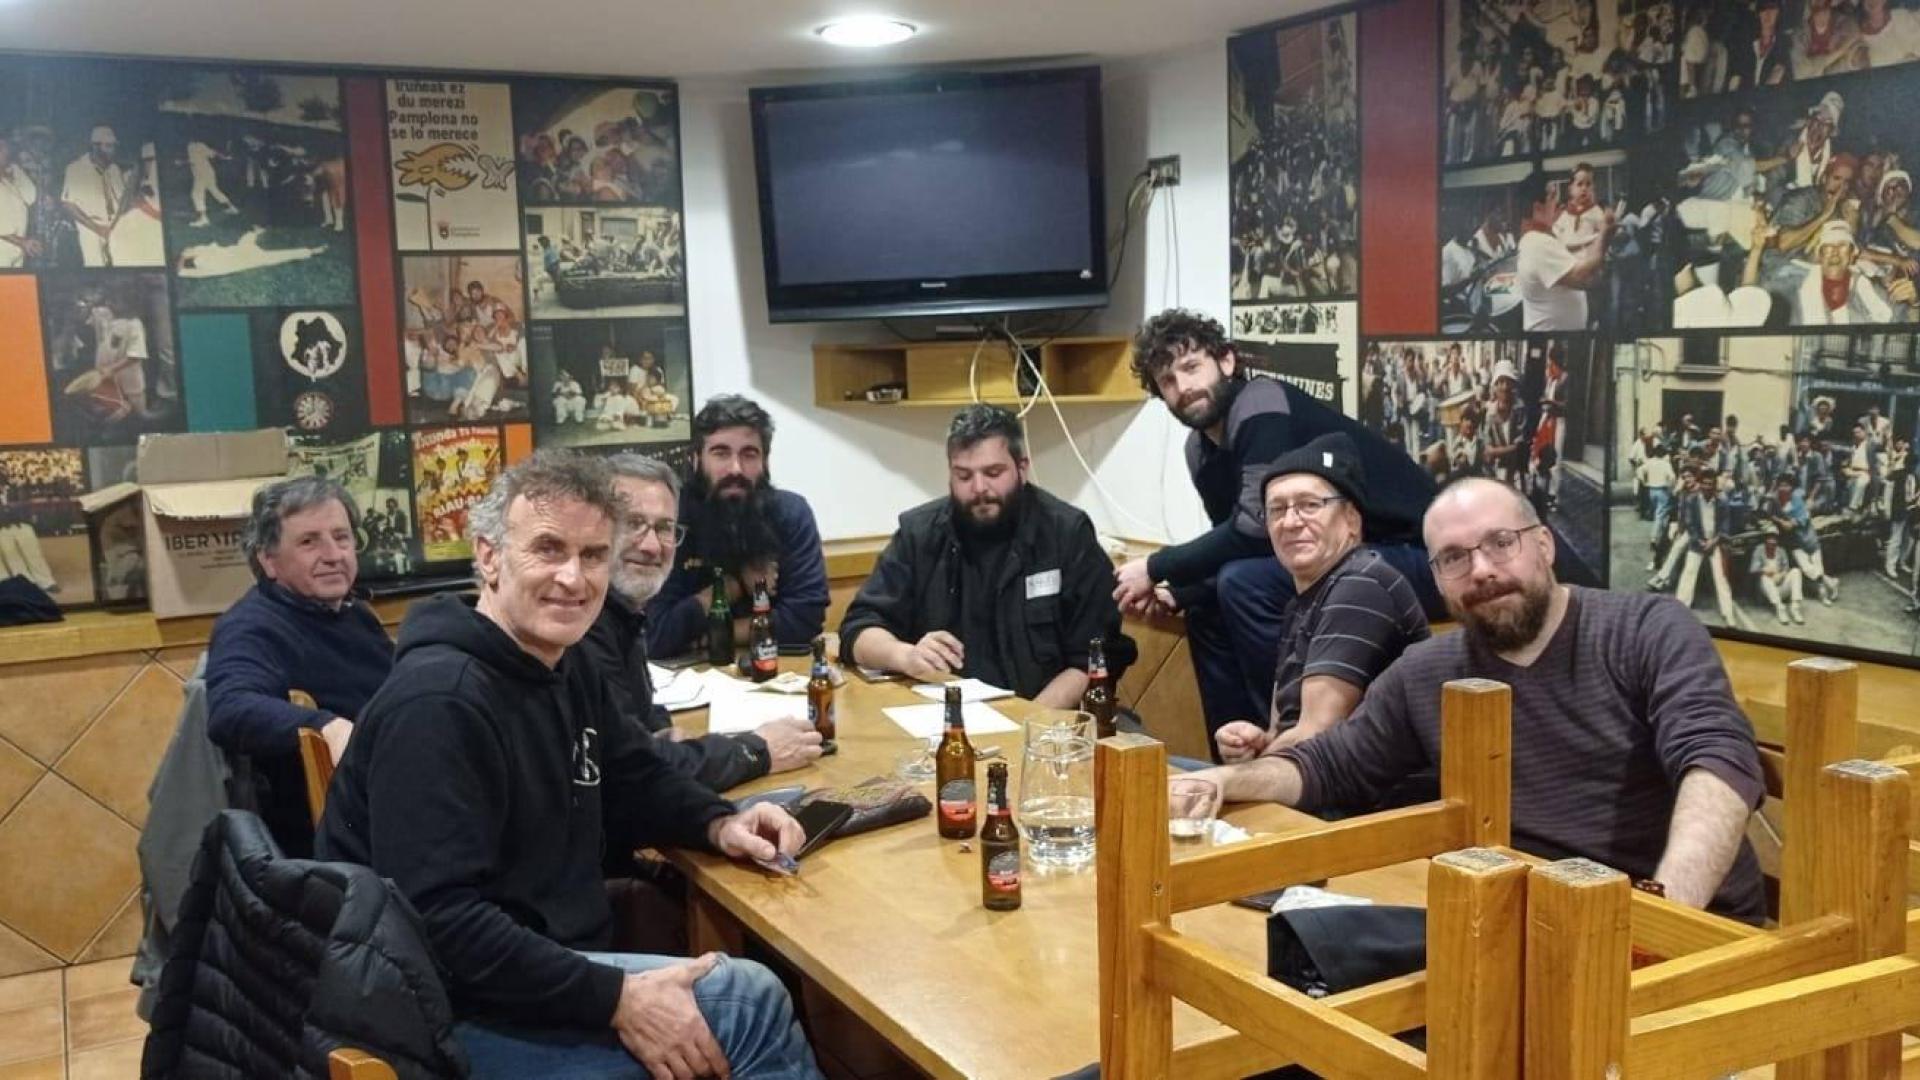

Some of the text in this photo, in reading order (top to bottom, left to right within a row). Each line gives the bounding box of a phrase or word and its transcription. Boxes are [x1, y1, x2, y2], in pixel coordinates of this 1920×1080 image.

[397, 94, 465, 109] du merezi
[389, 110, 479, 127] Pamplona no
[391, 126, 479, 140] se lo merece
